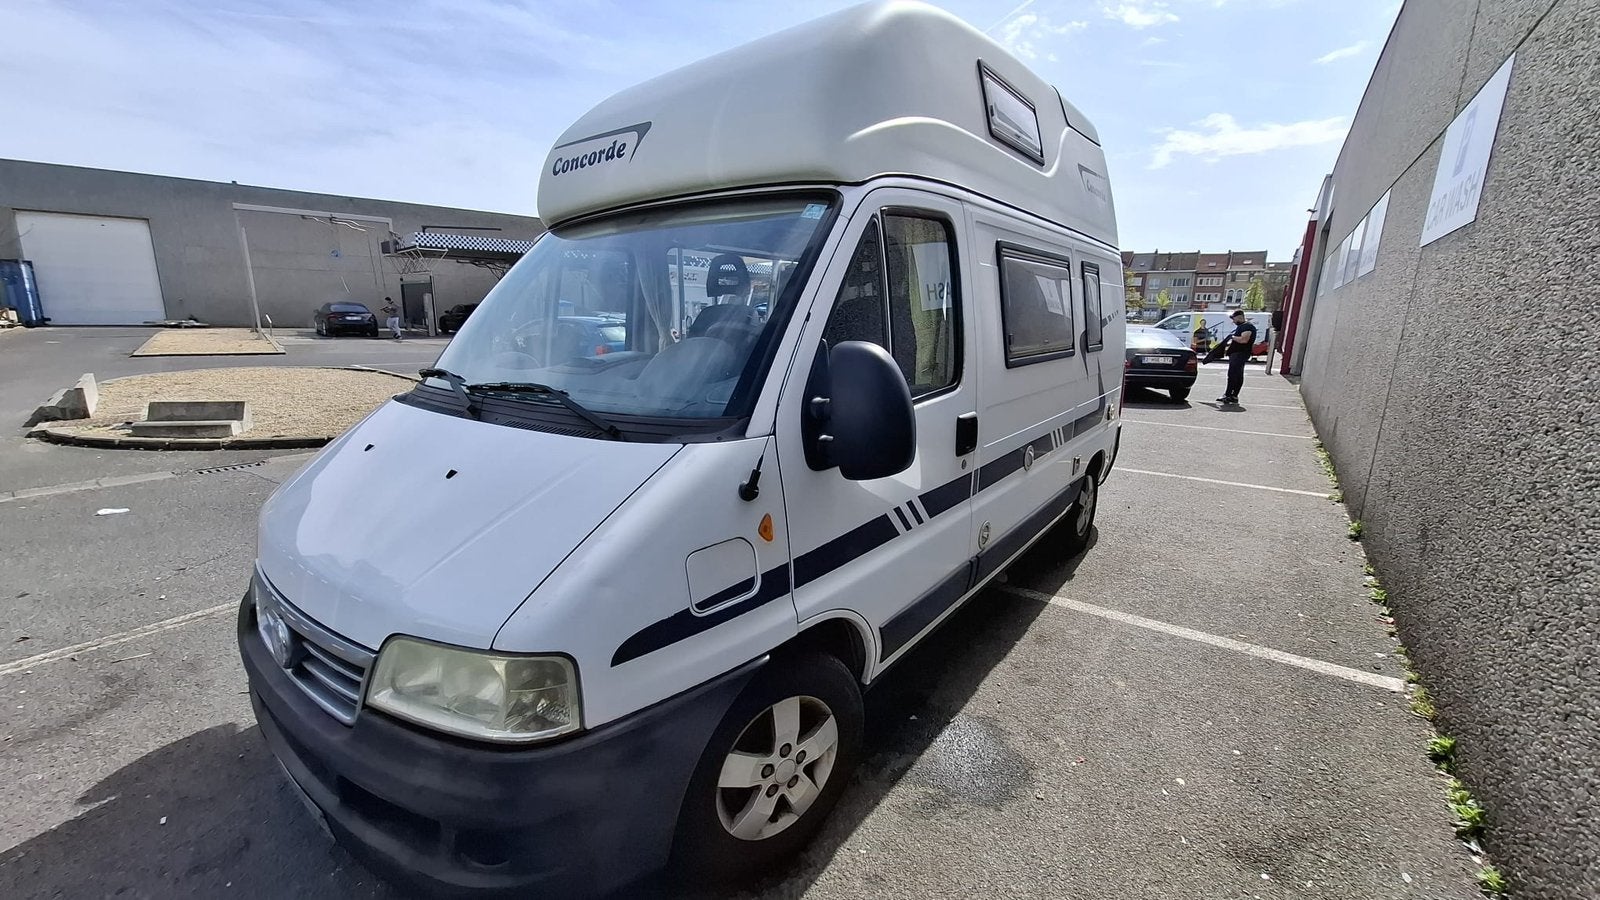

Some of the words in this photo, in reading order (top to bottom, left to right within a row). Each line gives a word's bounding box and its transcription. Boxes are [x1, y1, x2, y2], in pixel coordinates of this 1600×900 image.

[552, 139, 627, 176] Concorde
[1426, 192, 1448, 232] CAR
[1444, 166, 1482, 221] WASH
